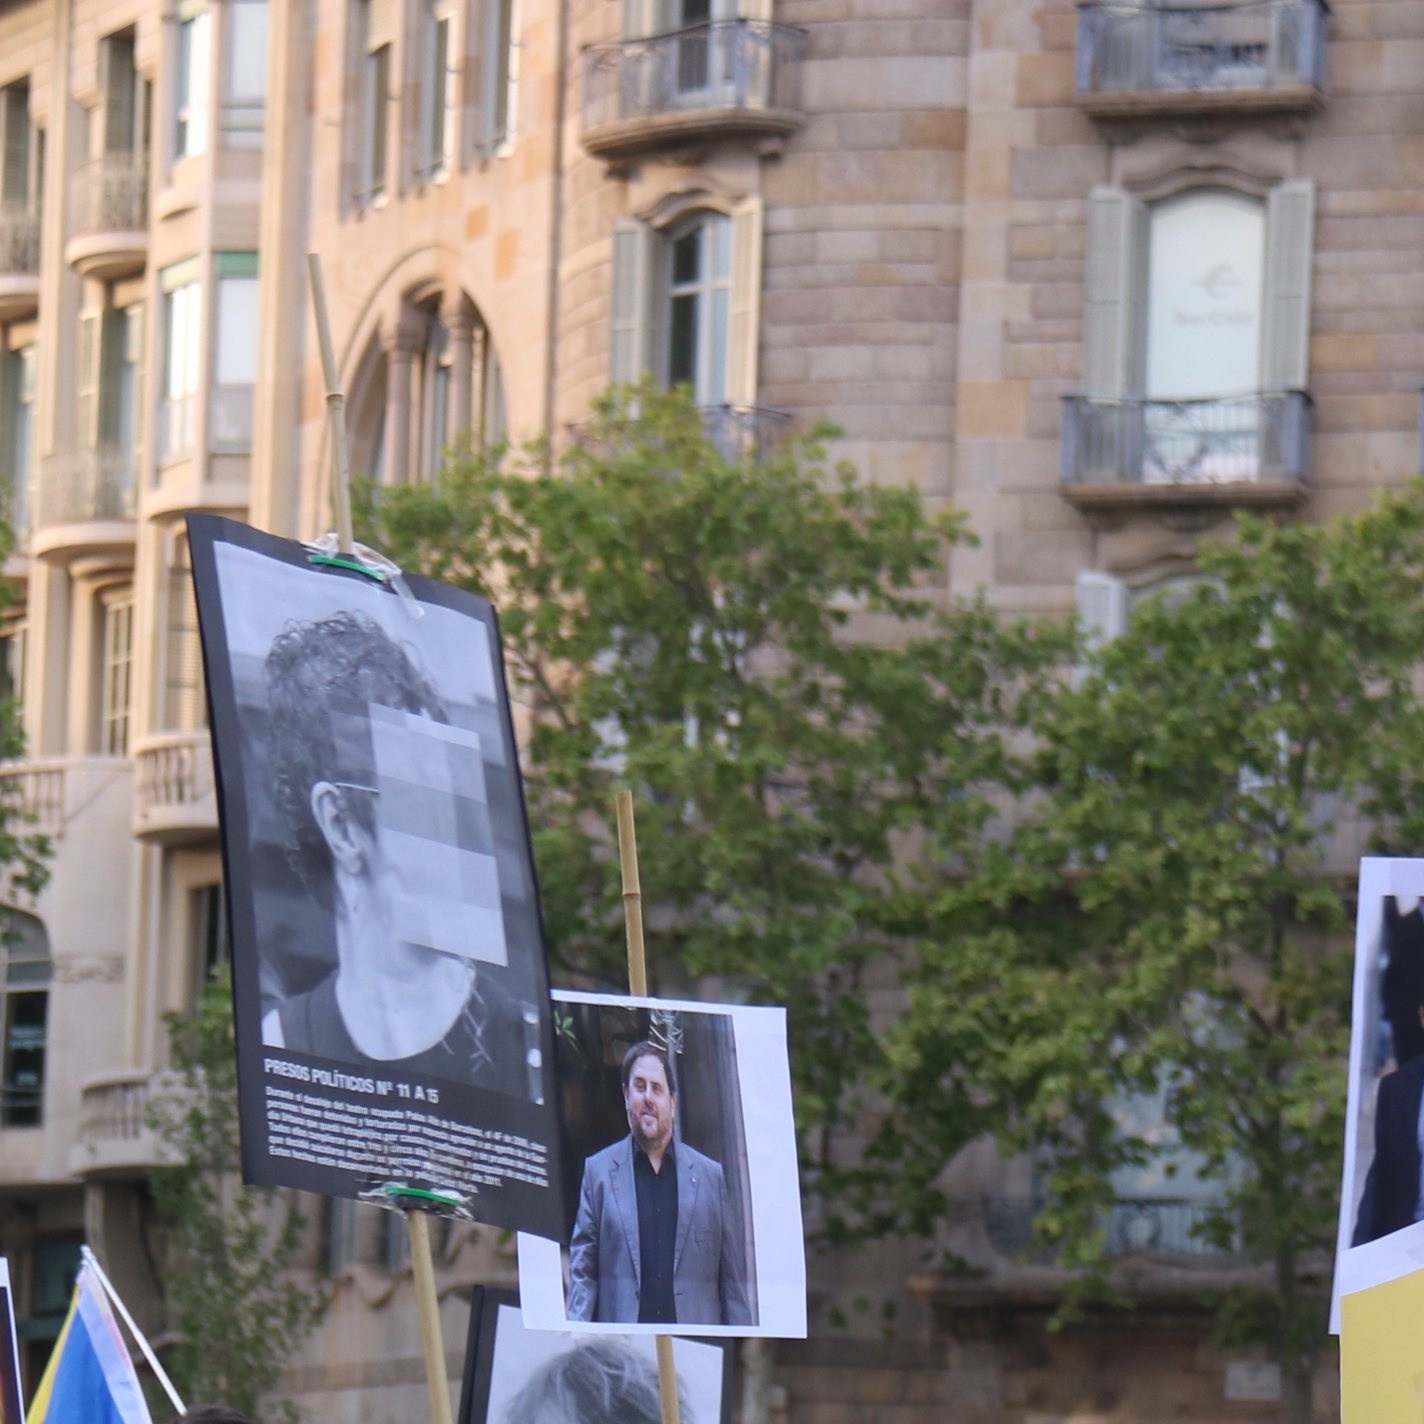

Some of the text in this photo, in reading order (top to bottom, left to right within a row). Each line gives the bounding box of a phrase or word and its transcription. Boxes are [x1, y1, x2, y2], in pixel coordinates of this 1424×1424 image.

[264, 1058, 310, 1081] PRESOS
[311, 1069, 375, 1093] POLÍTICOS
[397, 1083, 410, 1098] 11
[414, 1085, 426, 1100] A
[426, 1088, 439, 1104] 15
